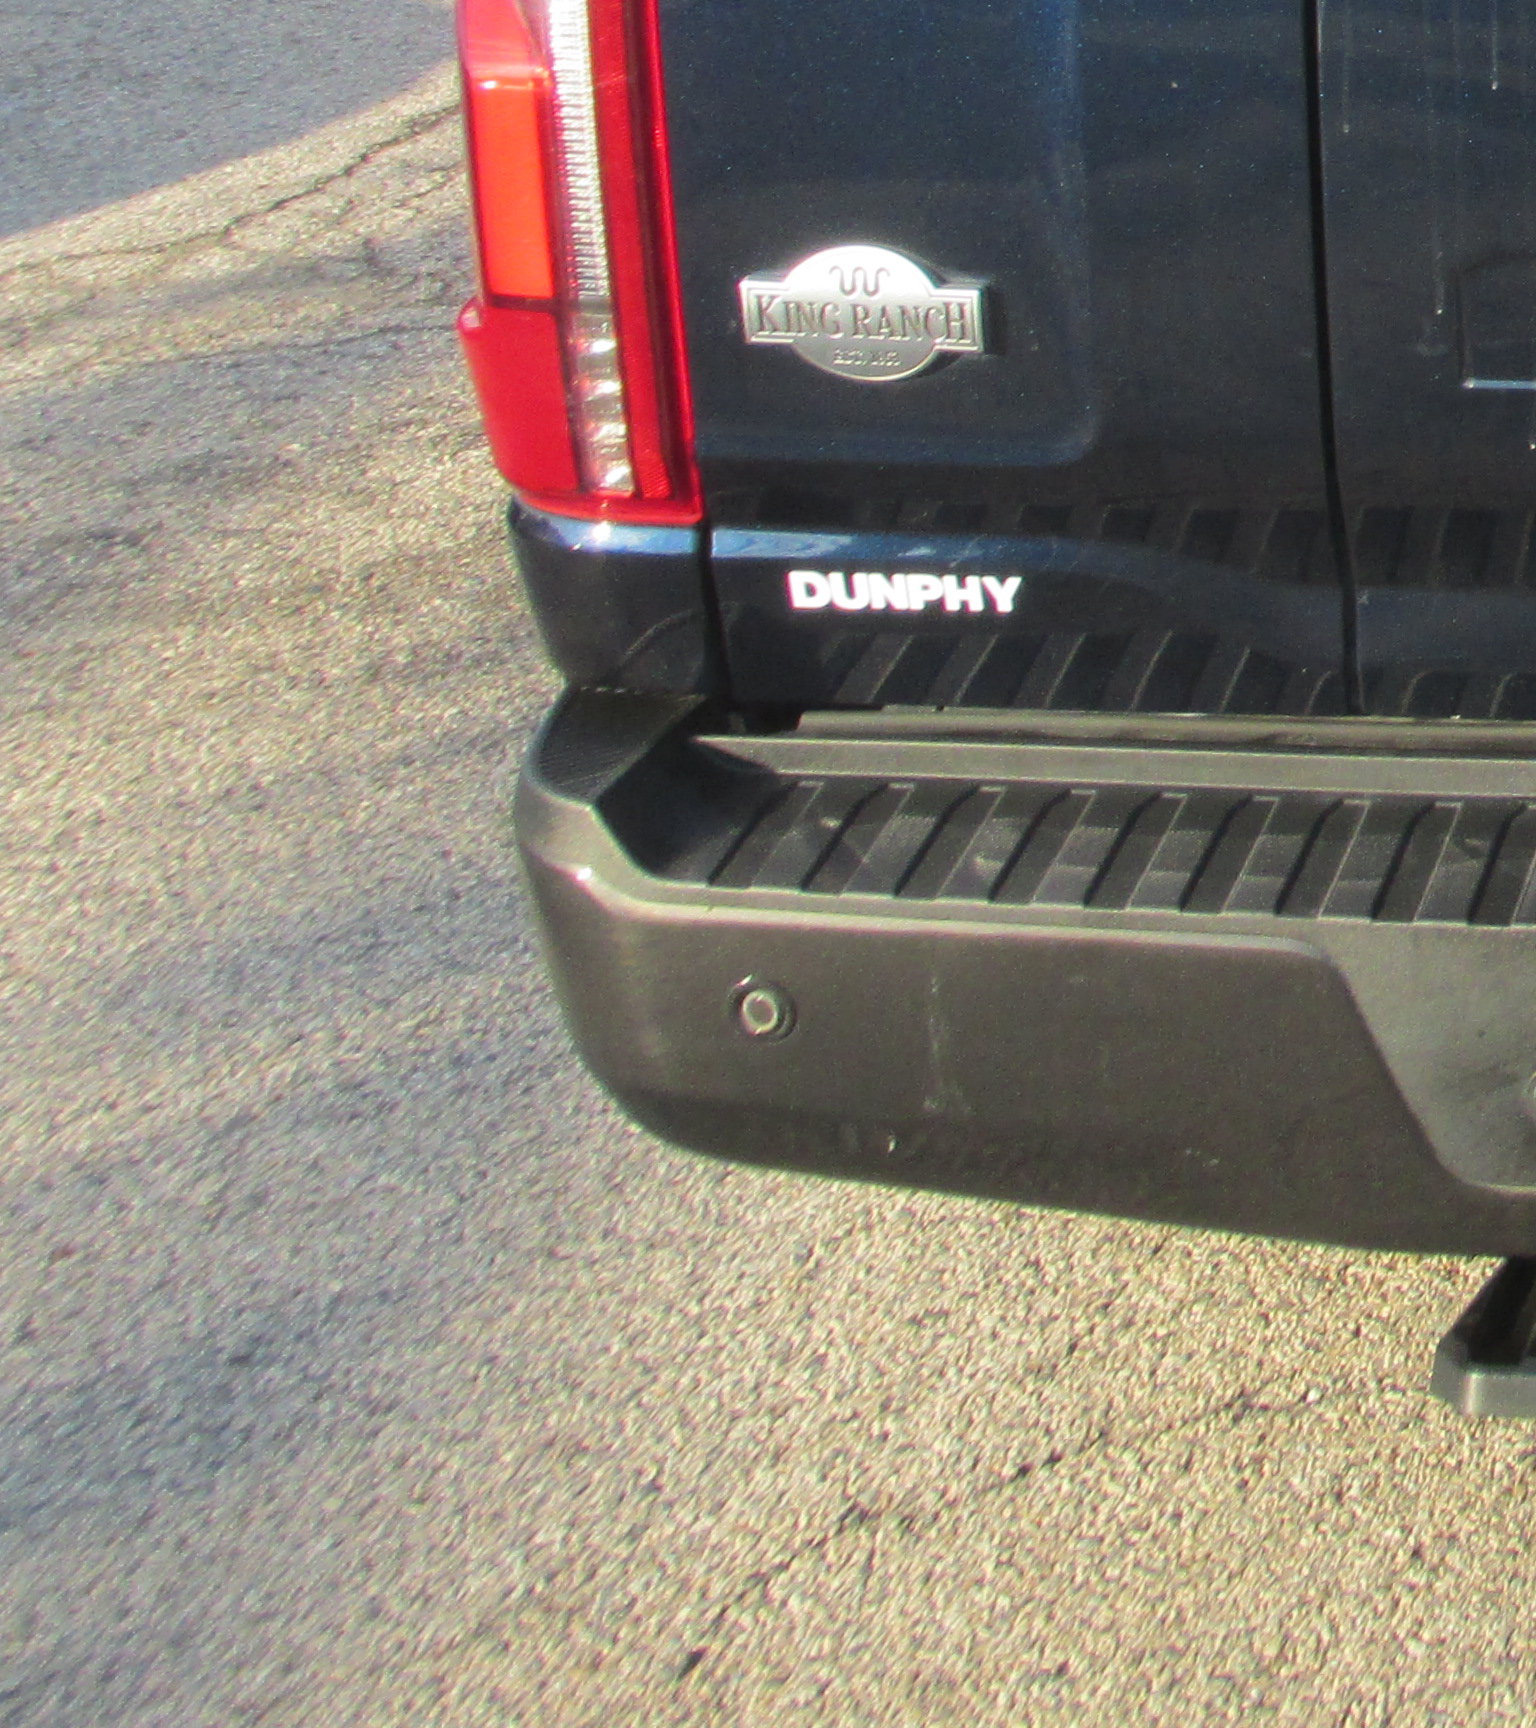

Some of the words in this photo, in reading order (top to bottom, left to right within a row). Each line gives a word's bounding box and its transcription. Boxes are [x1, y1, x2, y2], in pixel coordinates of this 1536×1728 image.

[756, 295, 843, 339] KING
[850, 302, 973, 344] RANCH
[788, 570, 1022, 613] DUNPHY
